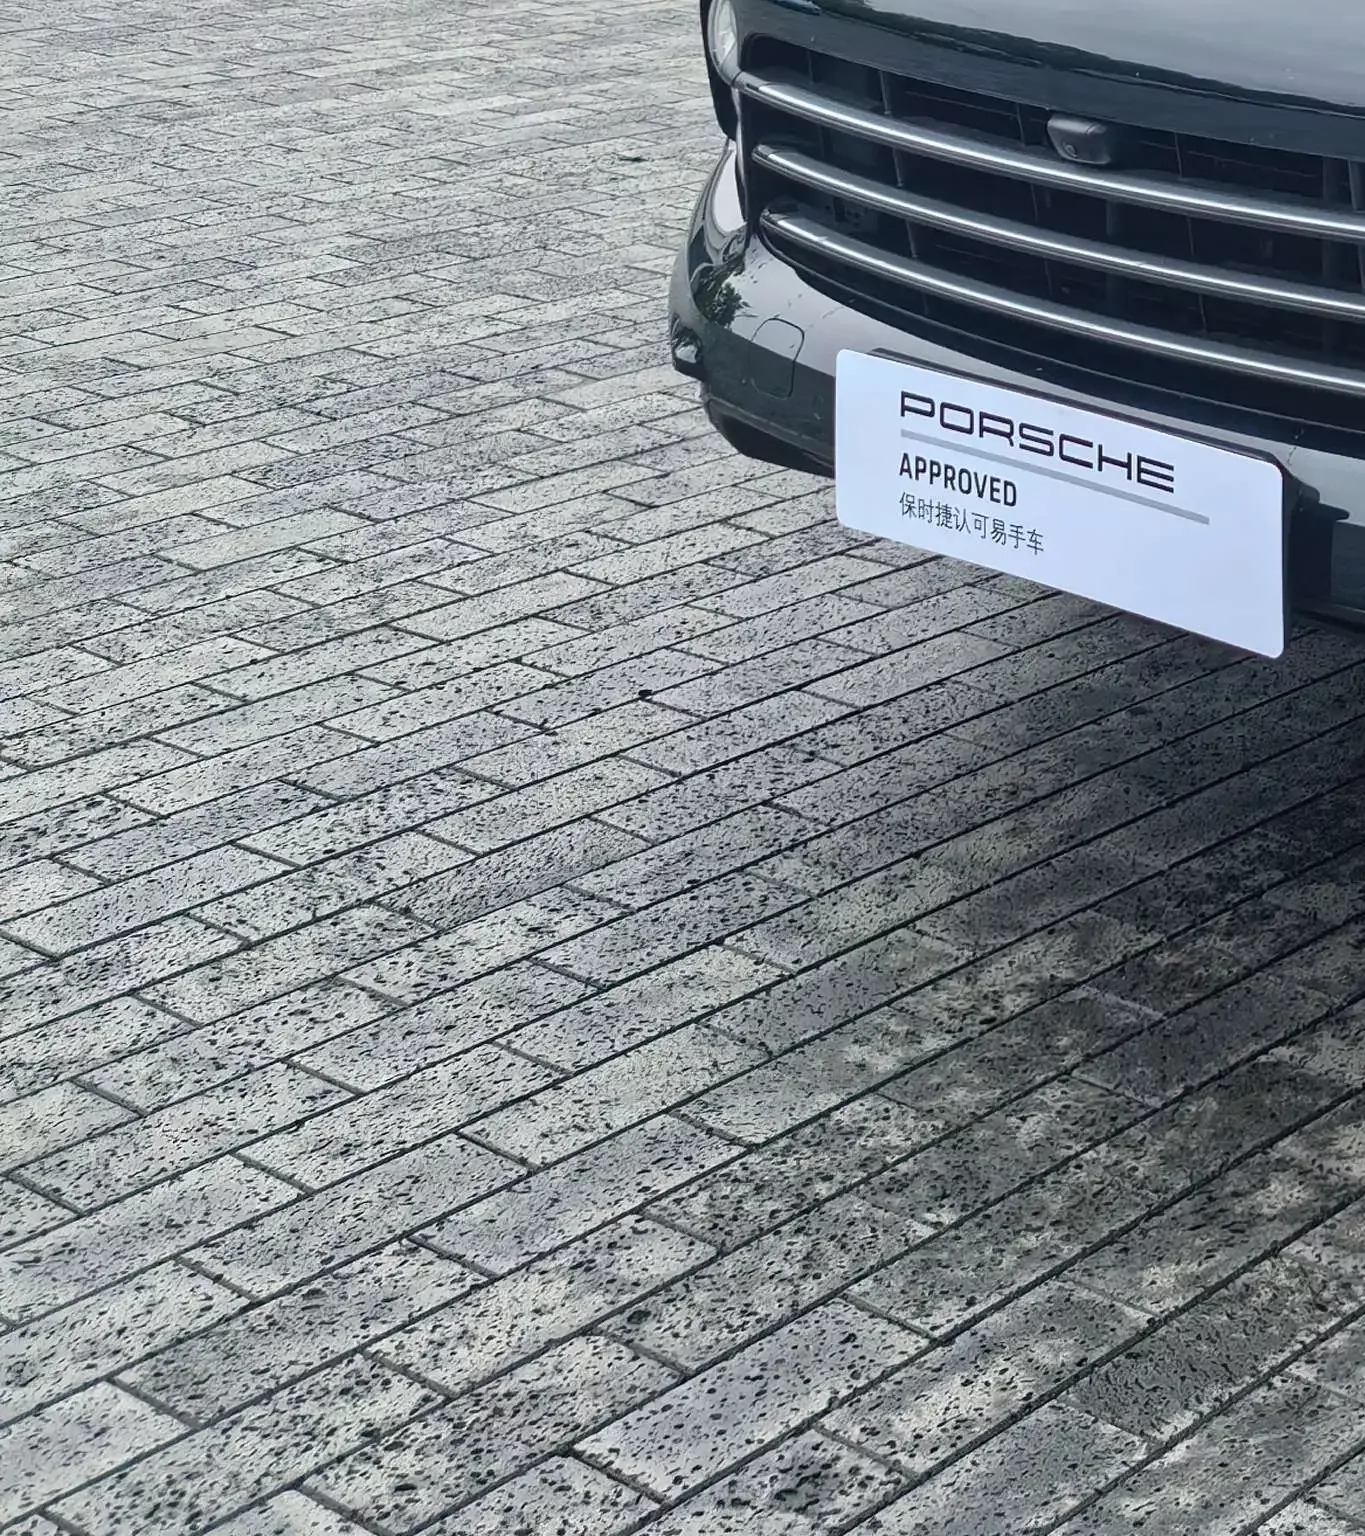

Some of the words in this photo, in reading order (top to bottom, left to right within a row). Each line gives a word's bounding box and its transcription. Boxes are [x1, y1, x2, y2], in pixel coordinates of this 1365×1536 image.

[900, 390, 1175, 494] PORSCHE
[899, 452, 1018, 508] APPROVED
[899, 491, 1044, 555] 保时捷认可易手车
